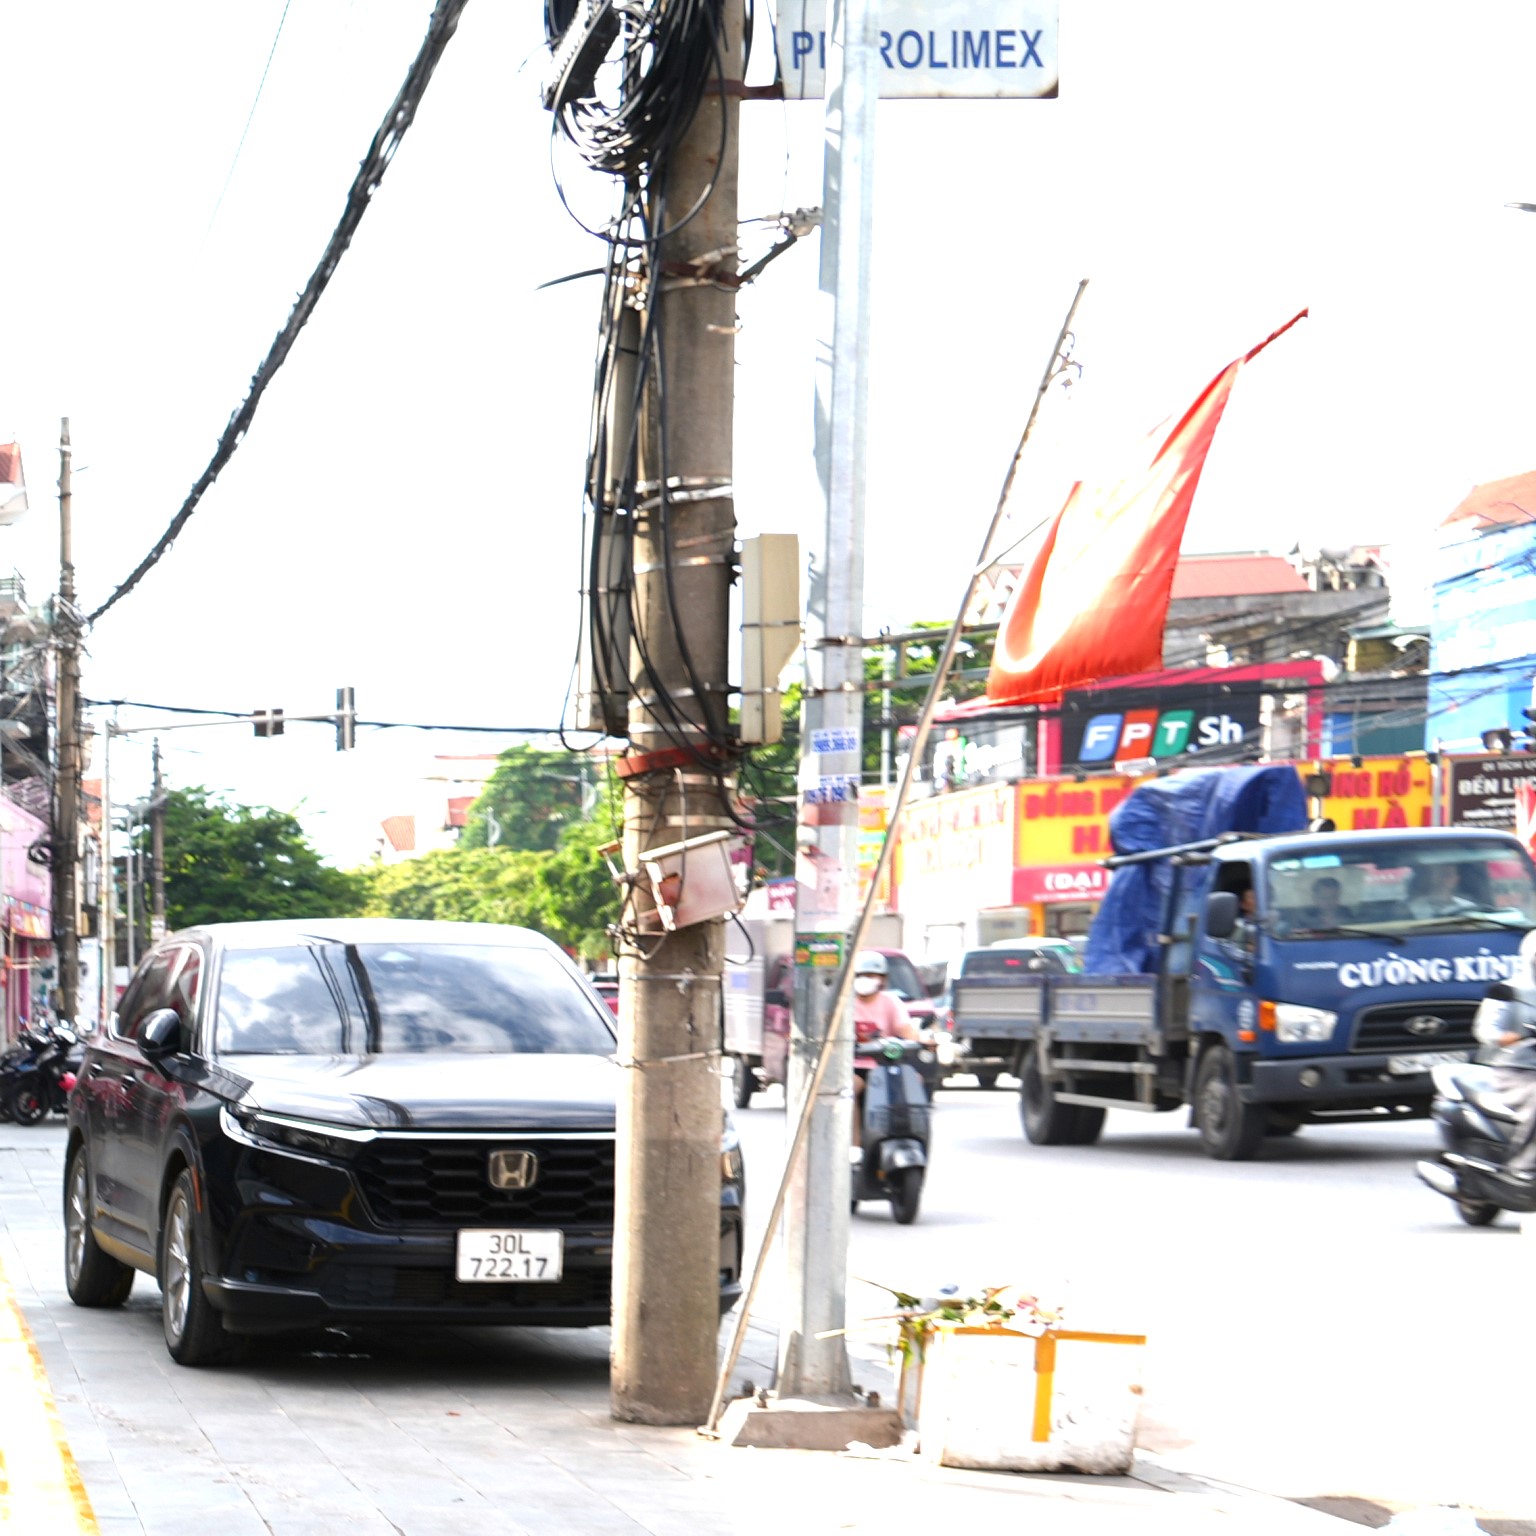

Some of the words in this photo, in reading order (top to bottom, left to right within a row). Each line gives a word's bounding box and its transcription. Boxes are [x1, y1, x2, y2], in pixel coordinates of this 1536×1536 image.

[791, 29, 1044, 70] PROLIMEX
[488, 1233, 532, 1255] 30L
[469, 1256, 549, 1279] 722.17
